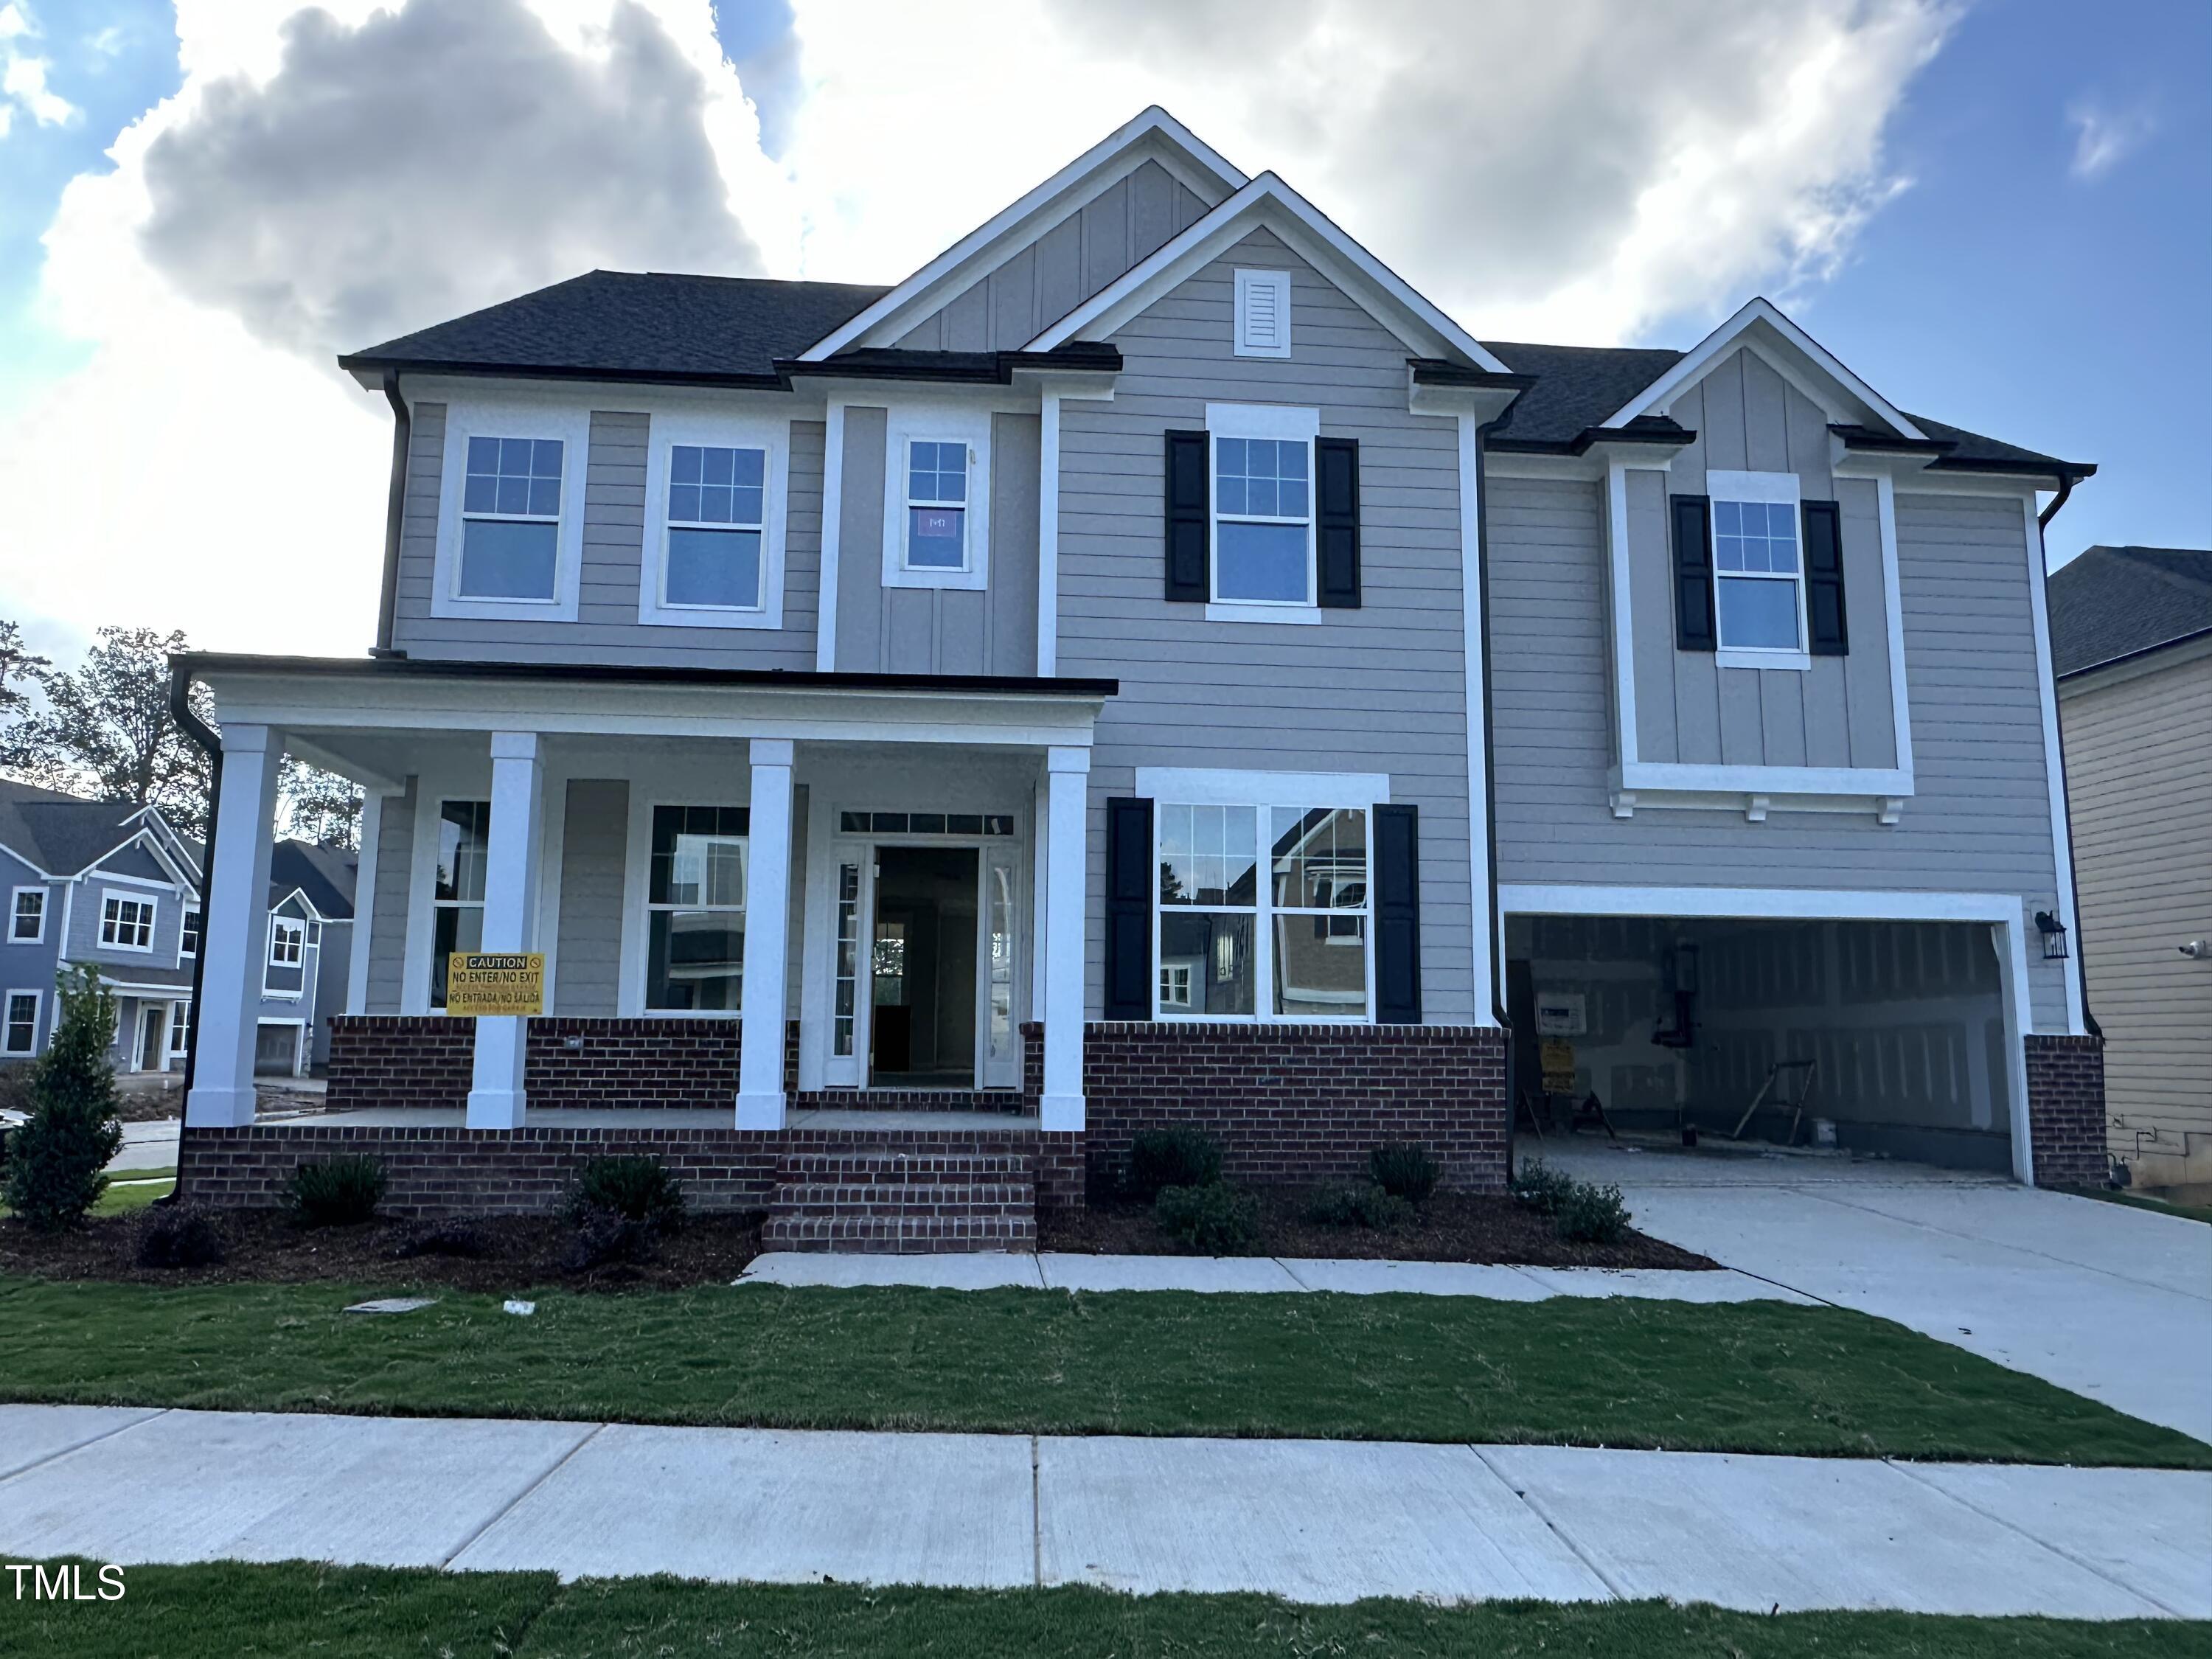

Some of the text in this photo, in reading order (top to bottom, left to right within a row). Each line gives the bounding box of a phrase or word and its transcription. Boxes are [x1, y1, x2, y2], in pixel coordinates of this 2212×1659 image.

[469, 957, 526, 968] CAUTION
[453, 971, 540, 983] NO ENTER/NO EXIT
[449, 992, 461, 1003] NO
